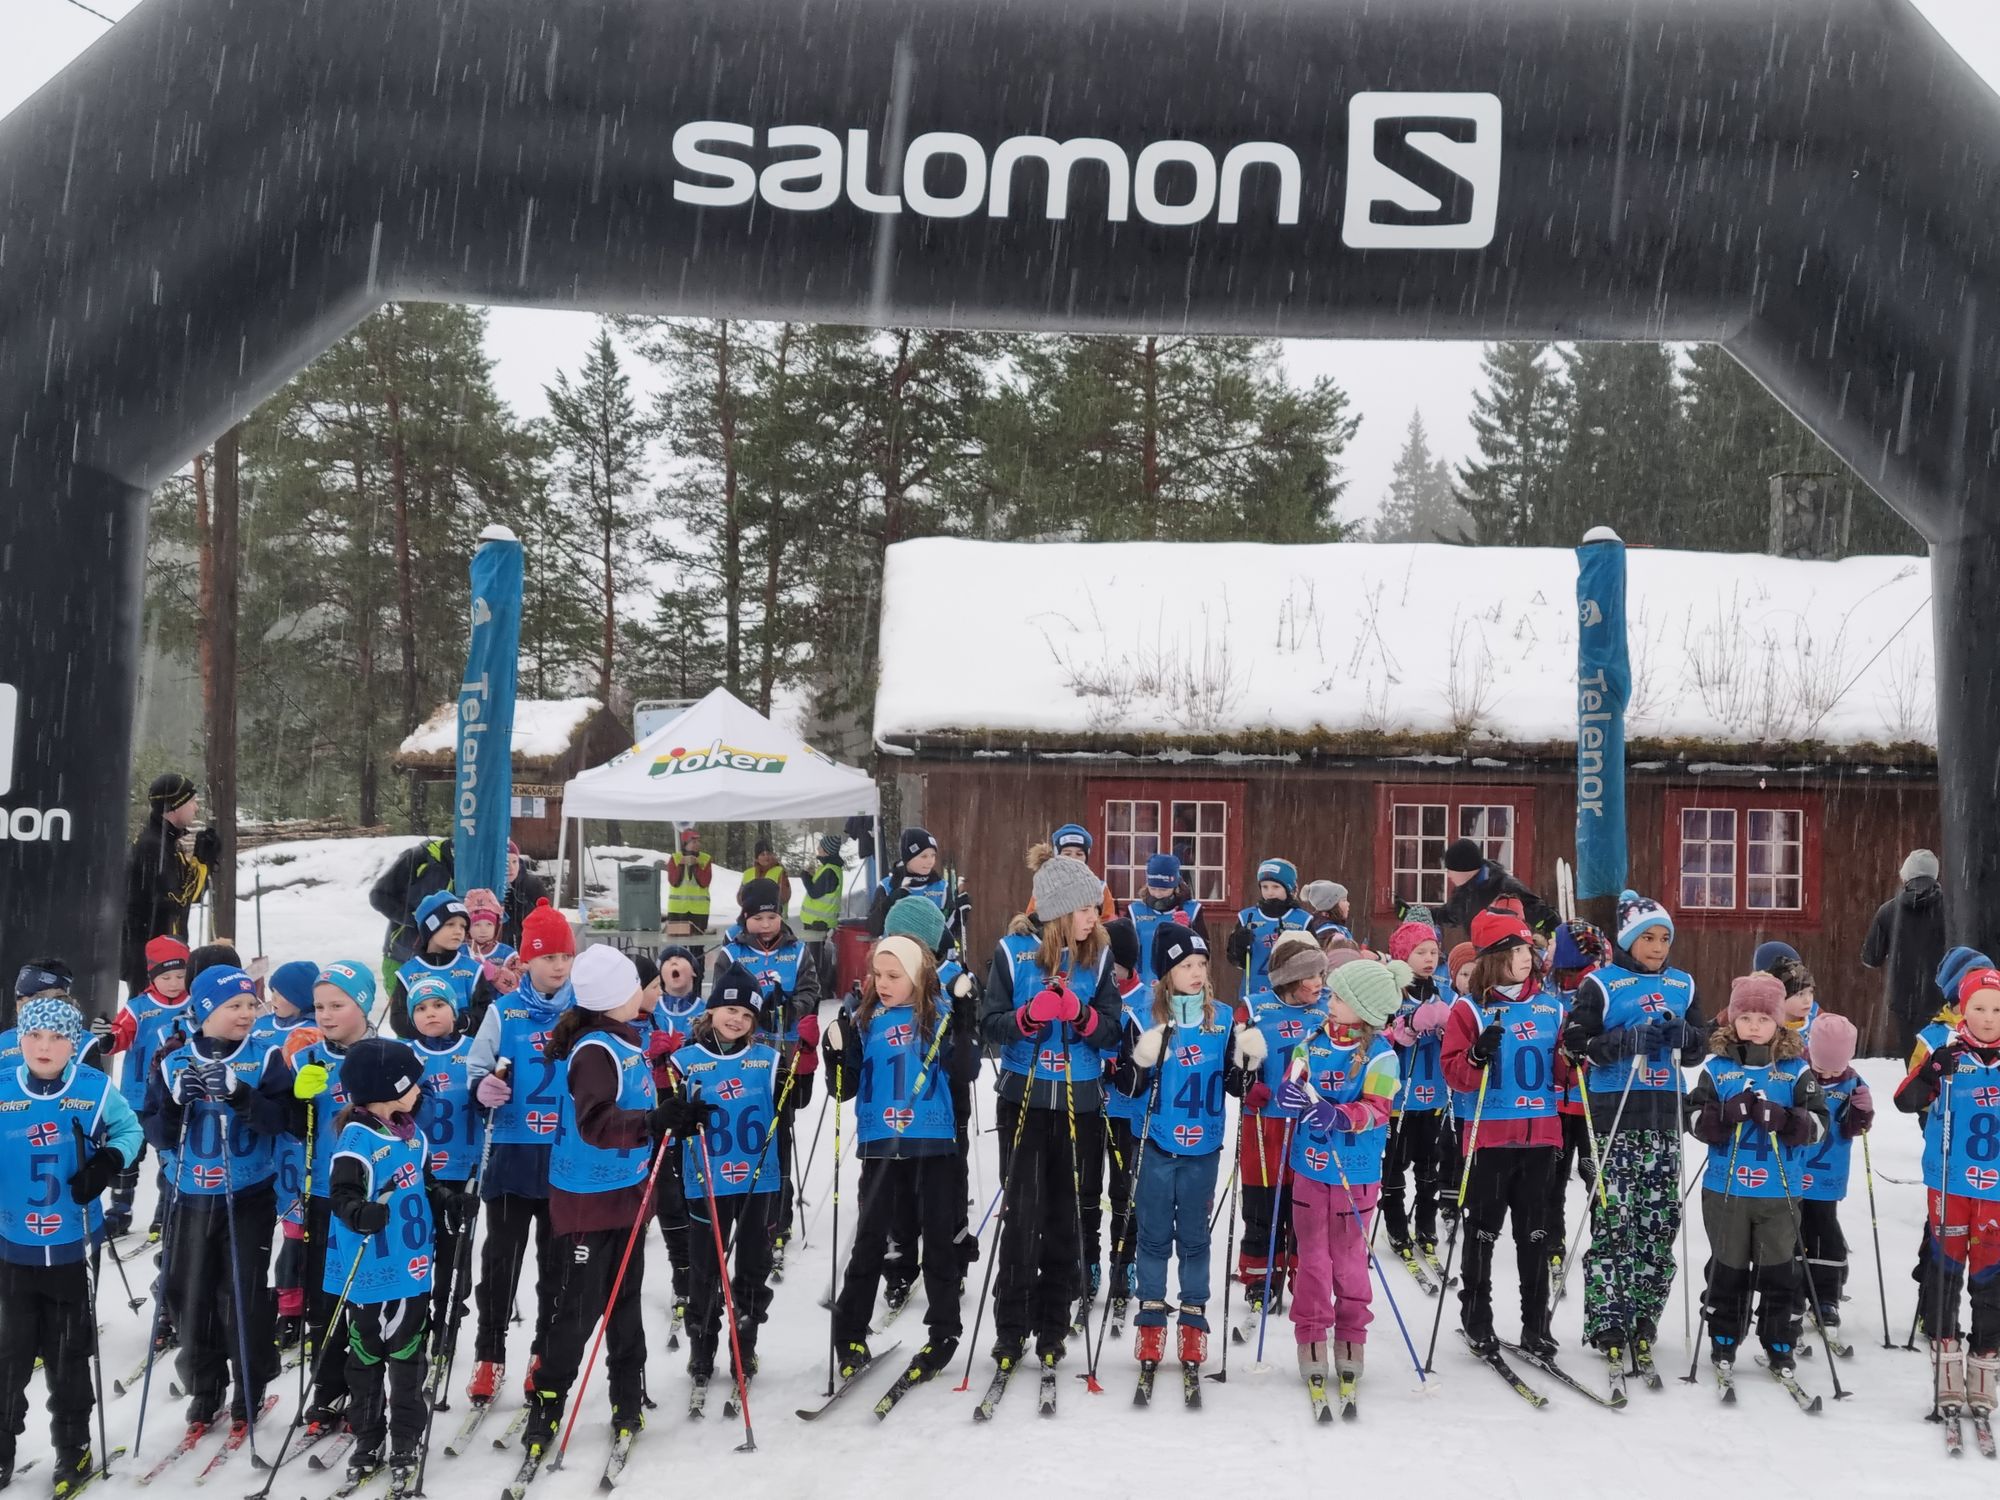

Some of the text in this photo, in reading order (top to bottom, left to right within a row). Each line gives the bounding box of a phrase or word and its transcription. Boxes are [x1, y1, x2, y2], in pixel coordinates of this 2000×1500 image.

[459, 672, 488, 836] Telenor
[652, 738, 778, 780] joker
[1579, 668, 1612, 817] Telenor
[707, 1104, 765, 1157] 86
[27, 1153, 61, 1208] 5
